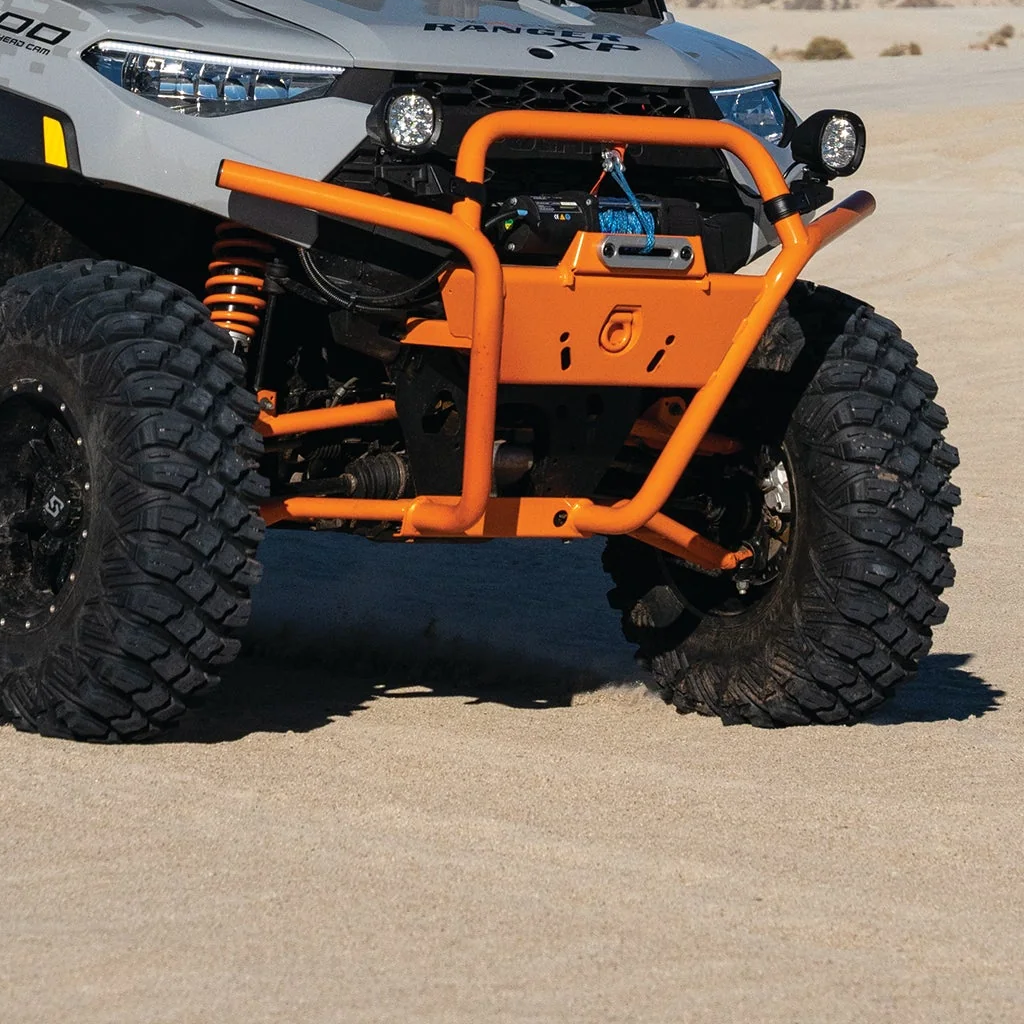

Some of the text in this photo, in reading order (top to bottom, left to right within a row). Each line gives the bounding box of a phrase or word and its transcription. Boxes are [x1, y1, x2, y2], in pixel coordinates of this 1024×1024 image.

[423, 22, 622, 42] RANGER
[25, 43, 51, 56] CAM
[547, 38, 641, 53] XP
